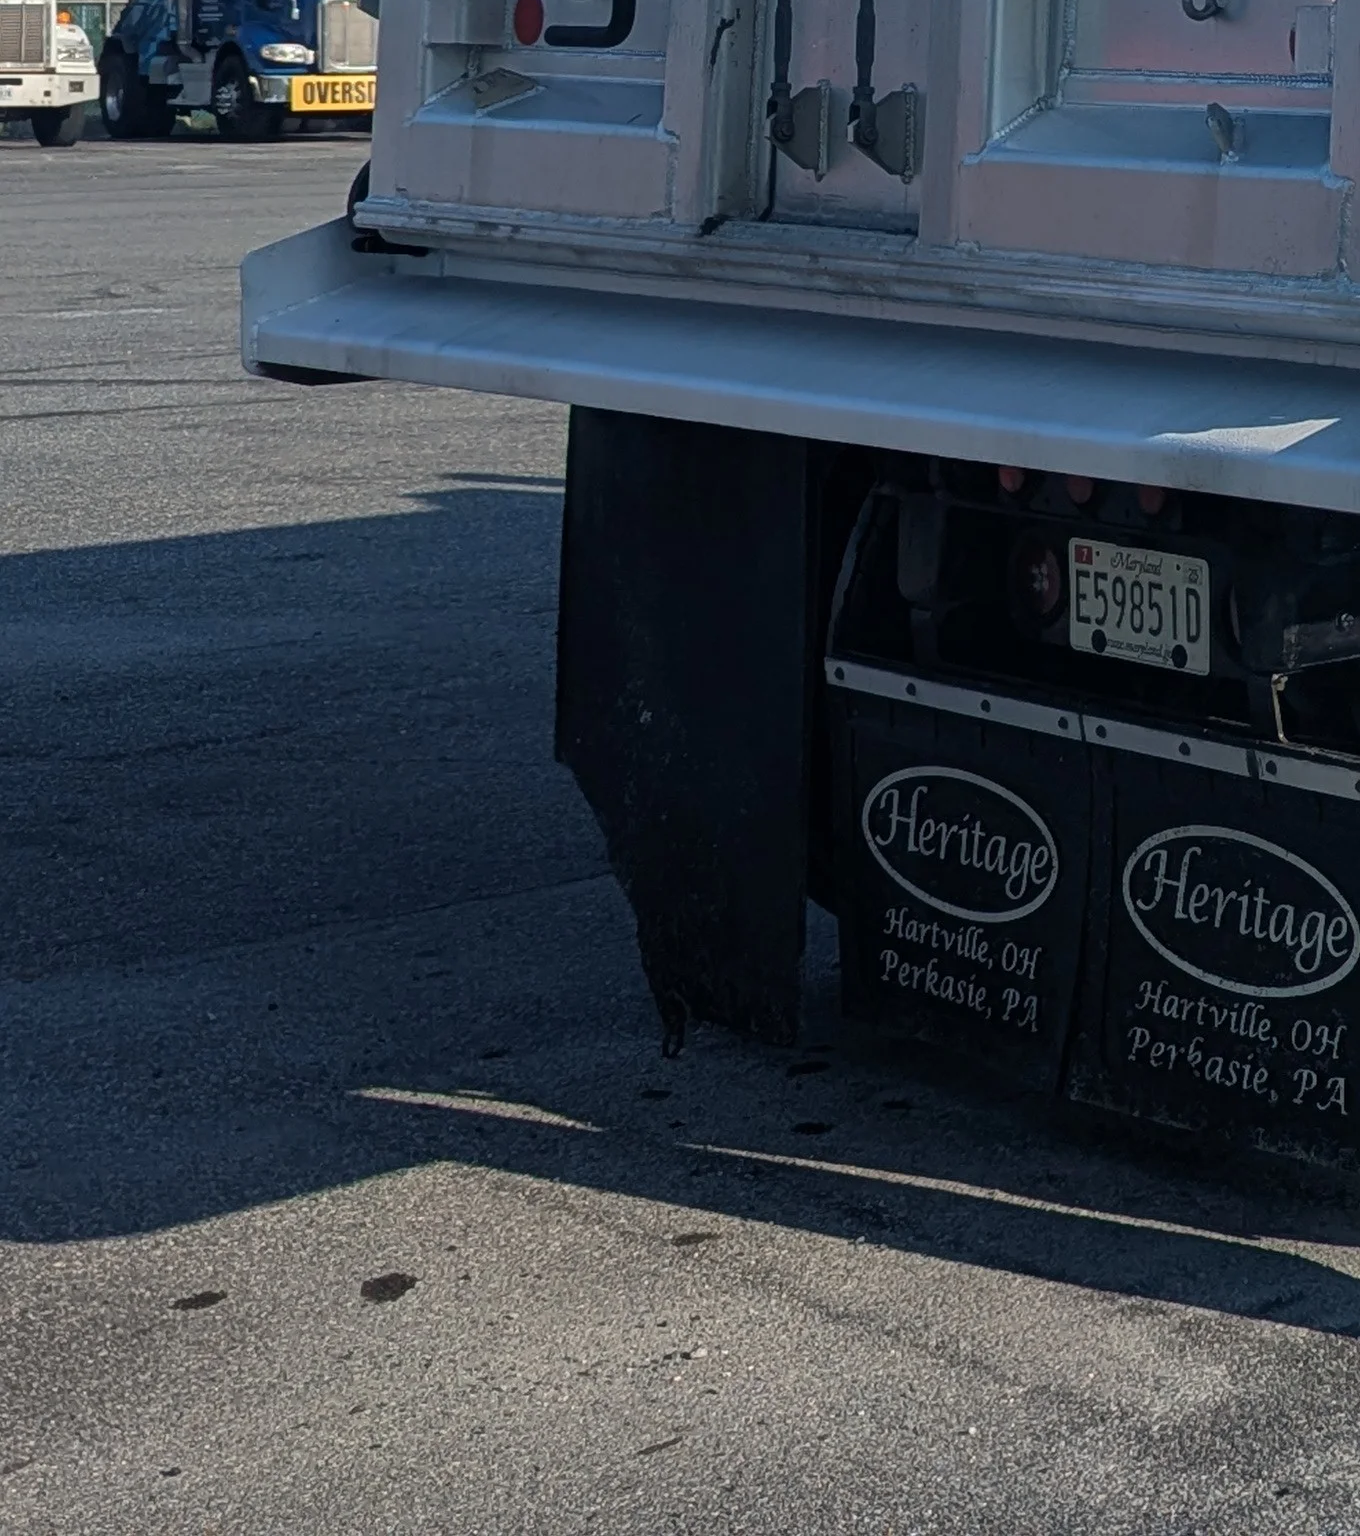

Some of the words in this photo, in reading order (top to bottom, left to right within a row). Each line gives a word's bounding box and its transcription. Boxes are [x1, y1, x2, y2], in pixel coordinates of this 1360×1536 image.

[1110, 551, 1163, 577] Maryland
[1076, 568, 1201, 644] E59851D
[875, 785, 1050, 900] Heritage
[883, 907, 993, 970] Hartville,
[1001, 942, 1044, 980] OH
[1136, 846, 1349, 974] Heritage
[879, 949, 993, 1020] Perkasie,
[1001, 987, 1039, 1032] PA
[1135, 980, 1279, 1048] Hartville,
[1291, 1019, 1348, 1060] OH
[1291, 1069, 1348, 1116] PA
